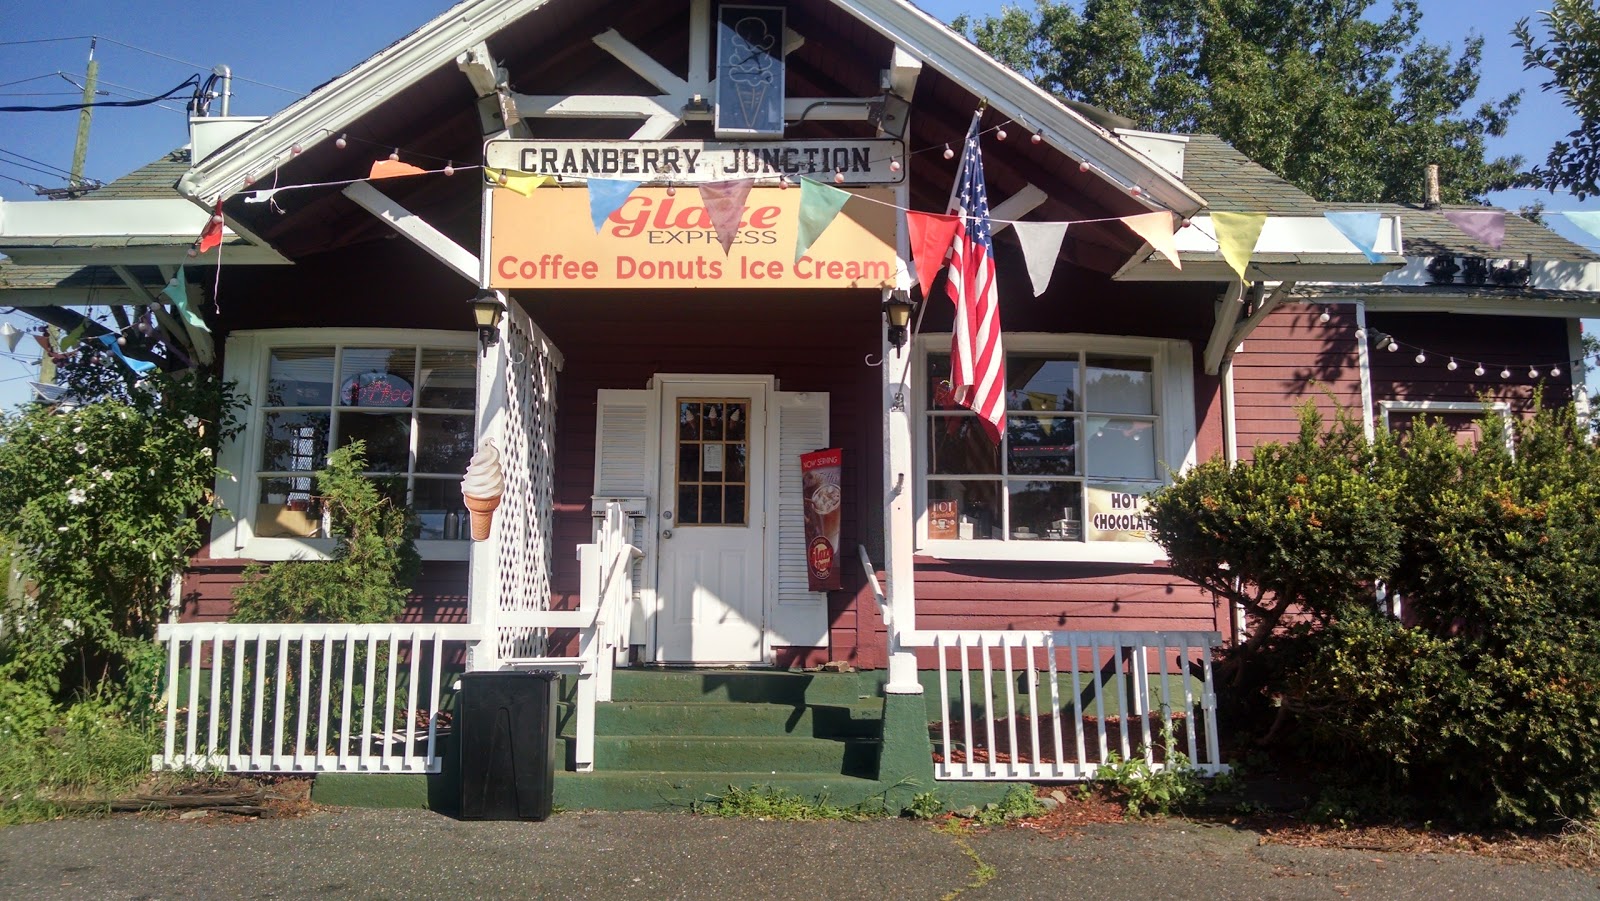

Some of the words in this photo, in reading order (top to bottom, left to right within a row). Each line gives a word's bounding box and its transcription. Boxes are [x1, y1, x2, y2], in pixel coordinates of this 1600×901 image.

[520, 147, 701, 174] CRANBERRY
[723, 147, 871, 174] JUNCTION
[648, 230, 777, 244] EXPRESS
[498, 255, 598, 280] Coffee
[616, 256, 723, 280] Donuts
[740, 256, 783, 280] Ice
[793, 256, 890, 280] Cream
[932, 501, 953, 512] HOT
[1111, 493, 1139, 509] HOT
